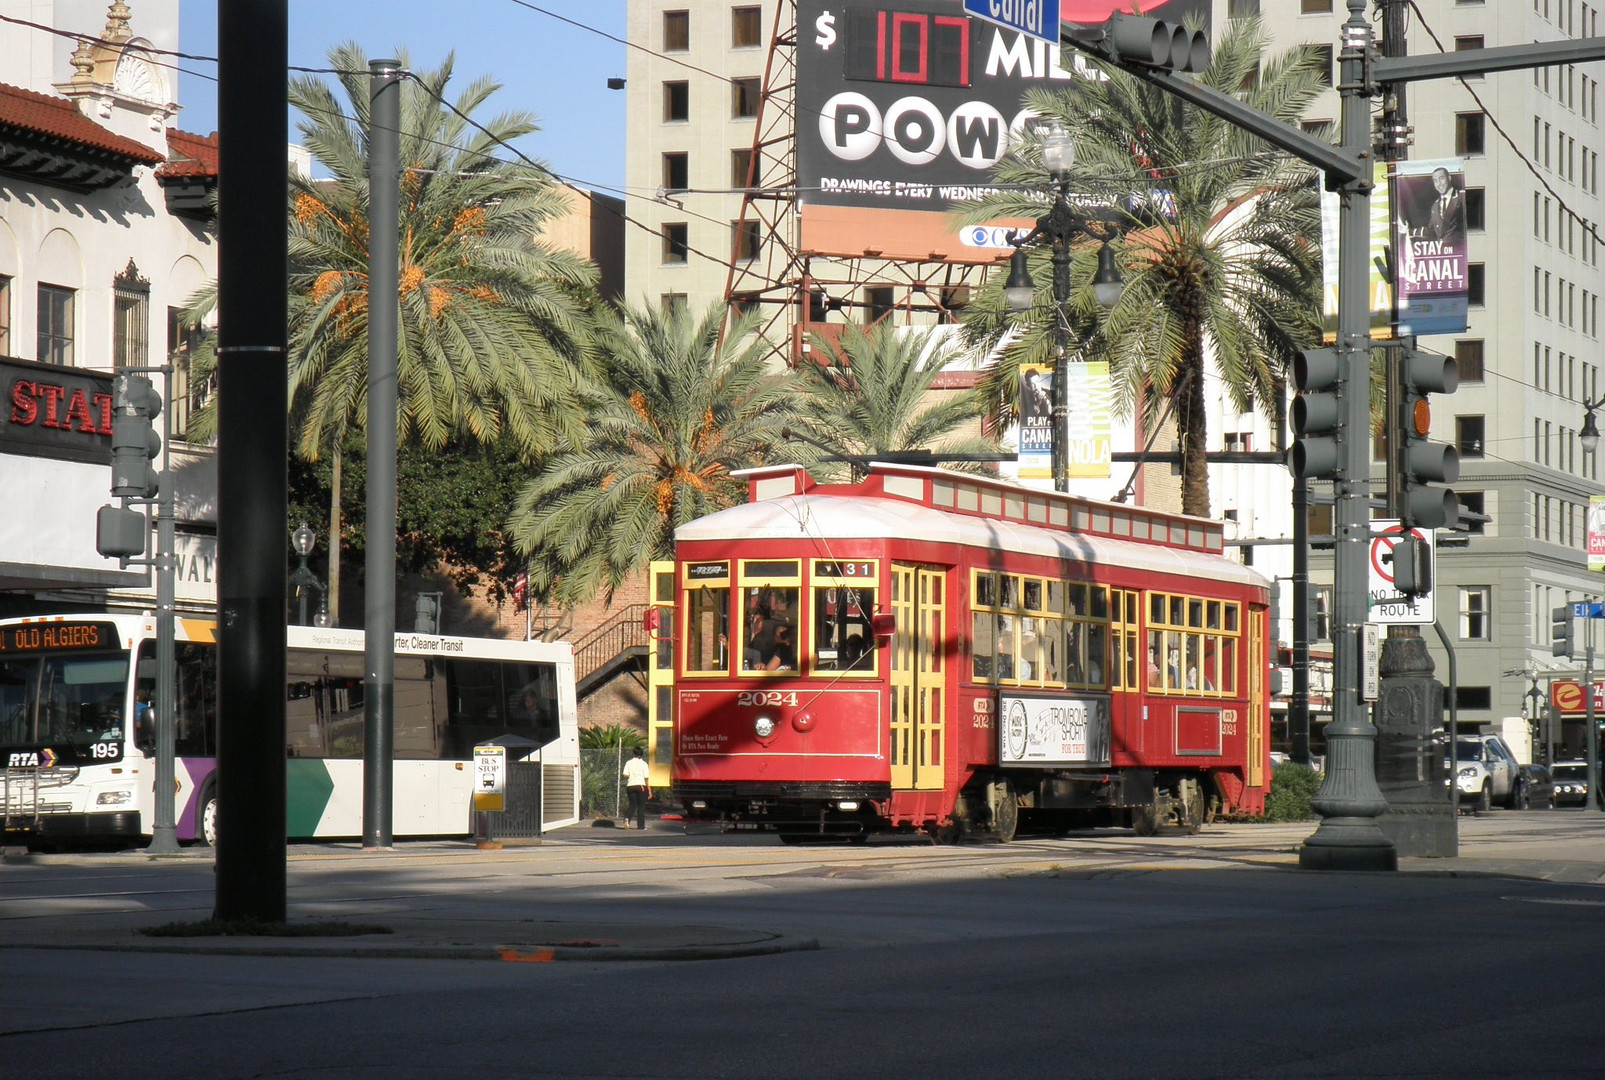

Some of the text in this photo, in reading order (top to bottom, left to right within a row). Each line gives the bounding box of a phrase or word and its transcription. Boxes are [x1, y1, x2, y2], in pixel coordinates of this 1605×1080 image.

[815, 10, 837, 50] $
[821, 177, 892, 196] DRAWINGS
[895, 181, 934, 199] EVERY
[1414, 241, 1443, 255] STAY
[1405, 259, 1464, 283] CANAL
[1405, 281, 1464, 290] STREET
[1323, 284, 1391, 315] NA
[12, 380, 112, 435] STAT
[1027, 416, 1047, 426] PLAY
[1068, 440, 1111, 464] NOLA
[1371, 590, 1386, 599] NO
[16, 629, 40, 649] OLD
[43, 625, 98, 647] ALGIERS
[411, 636, 439, 650] Cleaner
[440, 638, 463, 651] Transit
[738, 691, 798, 707] 2024
[1050, 707, 1088, 725] TROMBONE
[90, 743, 118, 758] 195
[8, 753, 39, 767] RTA
[481, 757, 497, 765] BUS
